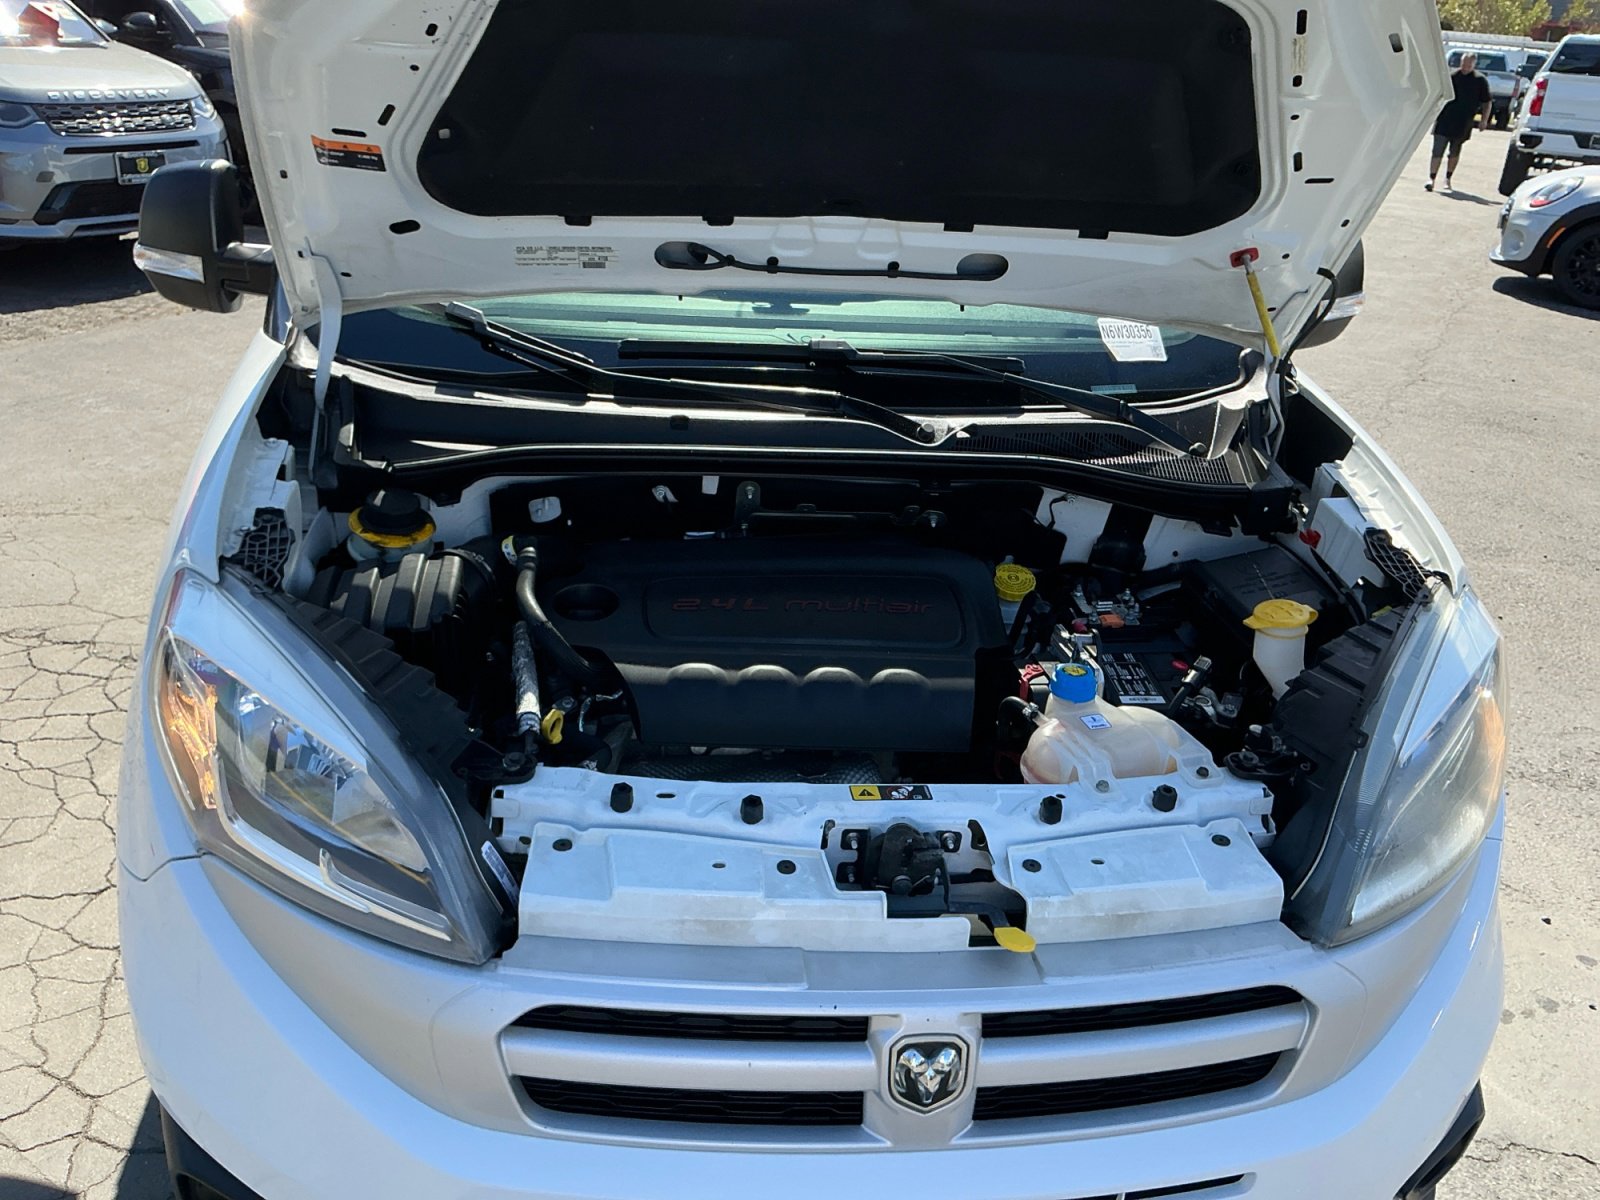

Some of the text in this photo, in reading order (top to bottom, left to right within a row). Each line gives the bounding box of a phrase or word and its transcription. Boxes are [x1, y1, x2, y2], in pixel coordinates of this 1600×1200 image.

[47, 88, 170, 101] DISCOVERY
[1101, 324, 1153, 339] N6W30356
[784, 597, 932, 613] multiair
